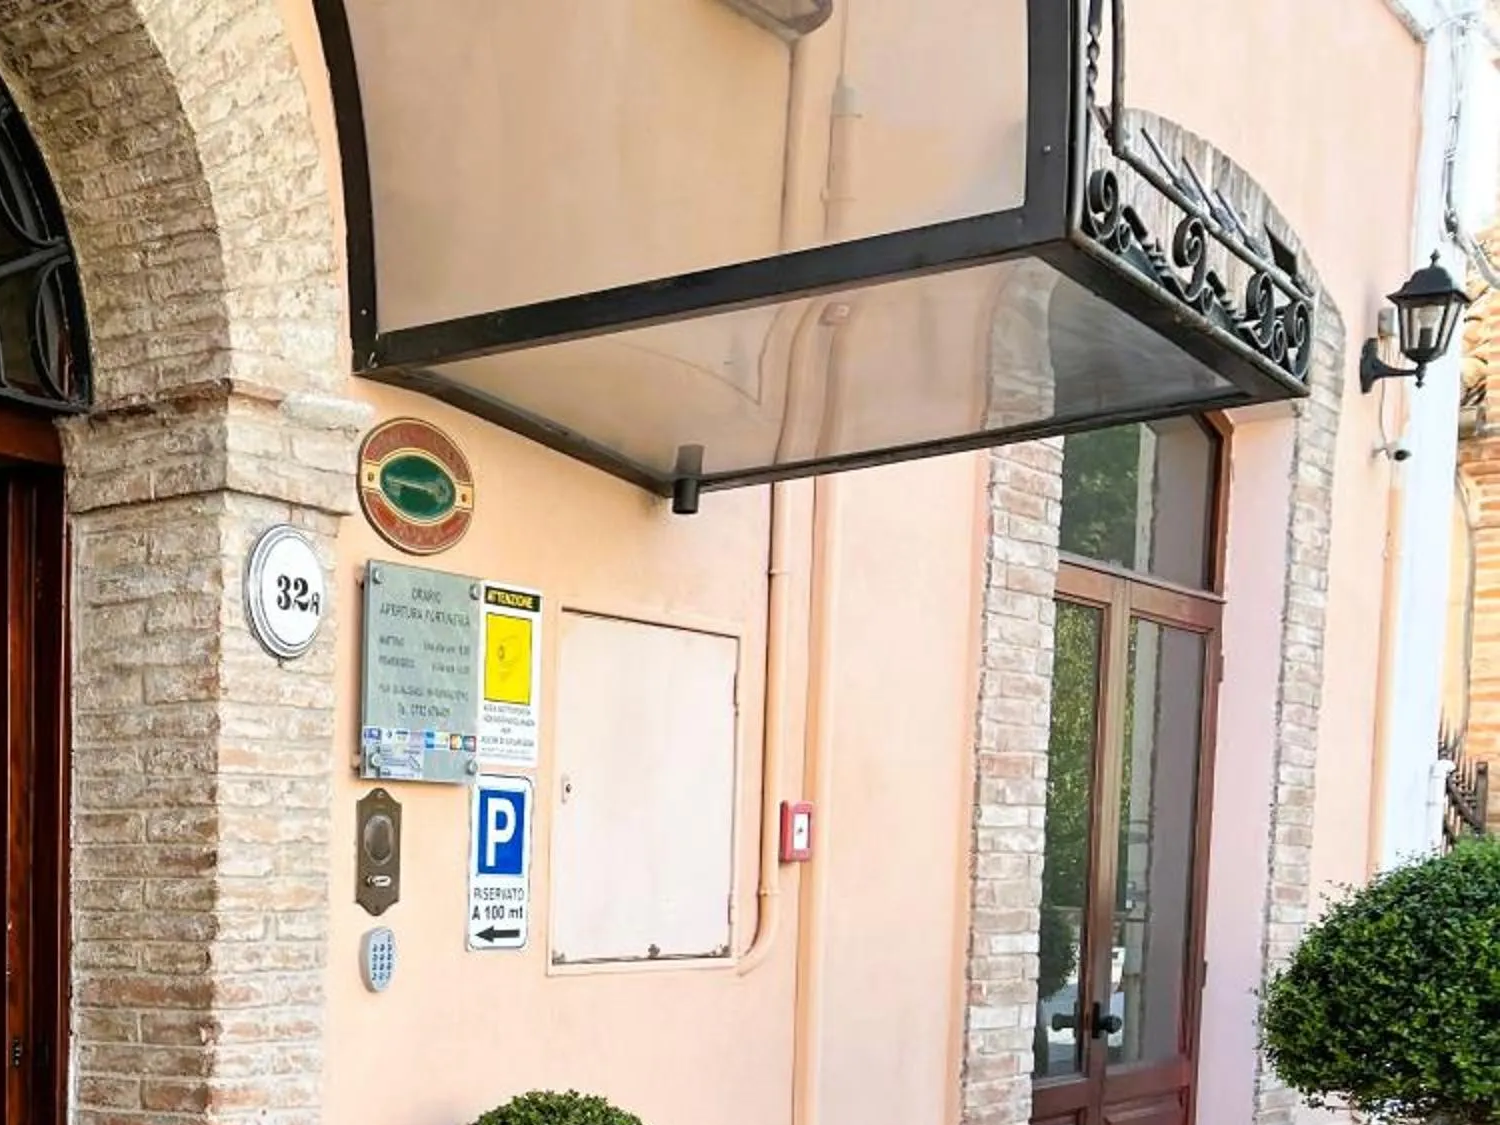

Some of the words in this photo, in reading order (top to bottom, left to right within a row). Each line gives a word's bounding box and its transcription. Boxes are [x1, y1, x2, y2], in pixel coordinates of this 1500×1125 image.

[487, 588, 533, 609] ATTENZIONE
[485, 796, 517, 867] P
[473, 887, 525, 901] RISERVATO
[471, 905, 481, 921] A
[484, 905, 505, 921] 100
[507, 905, 523, 919] mt
